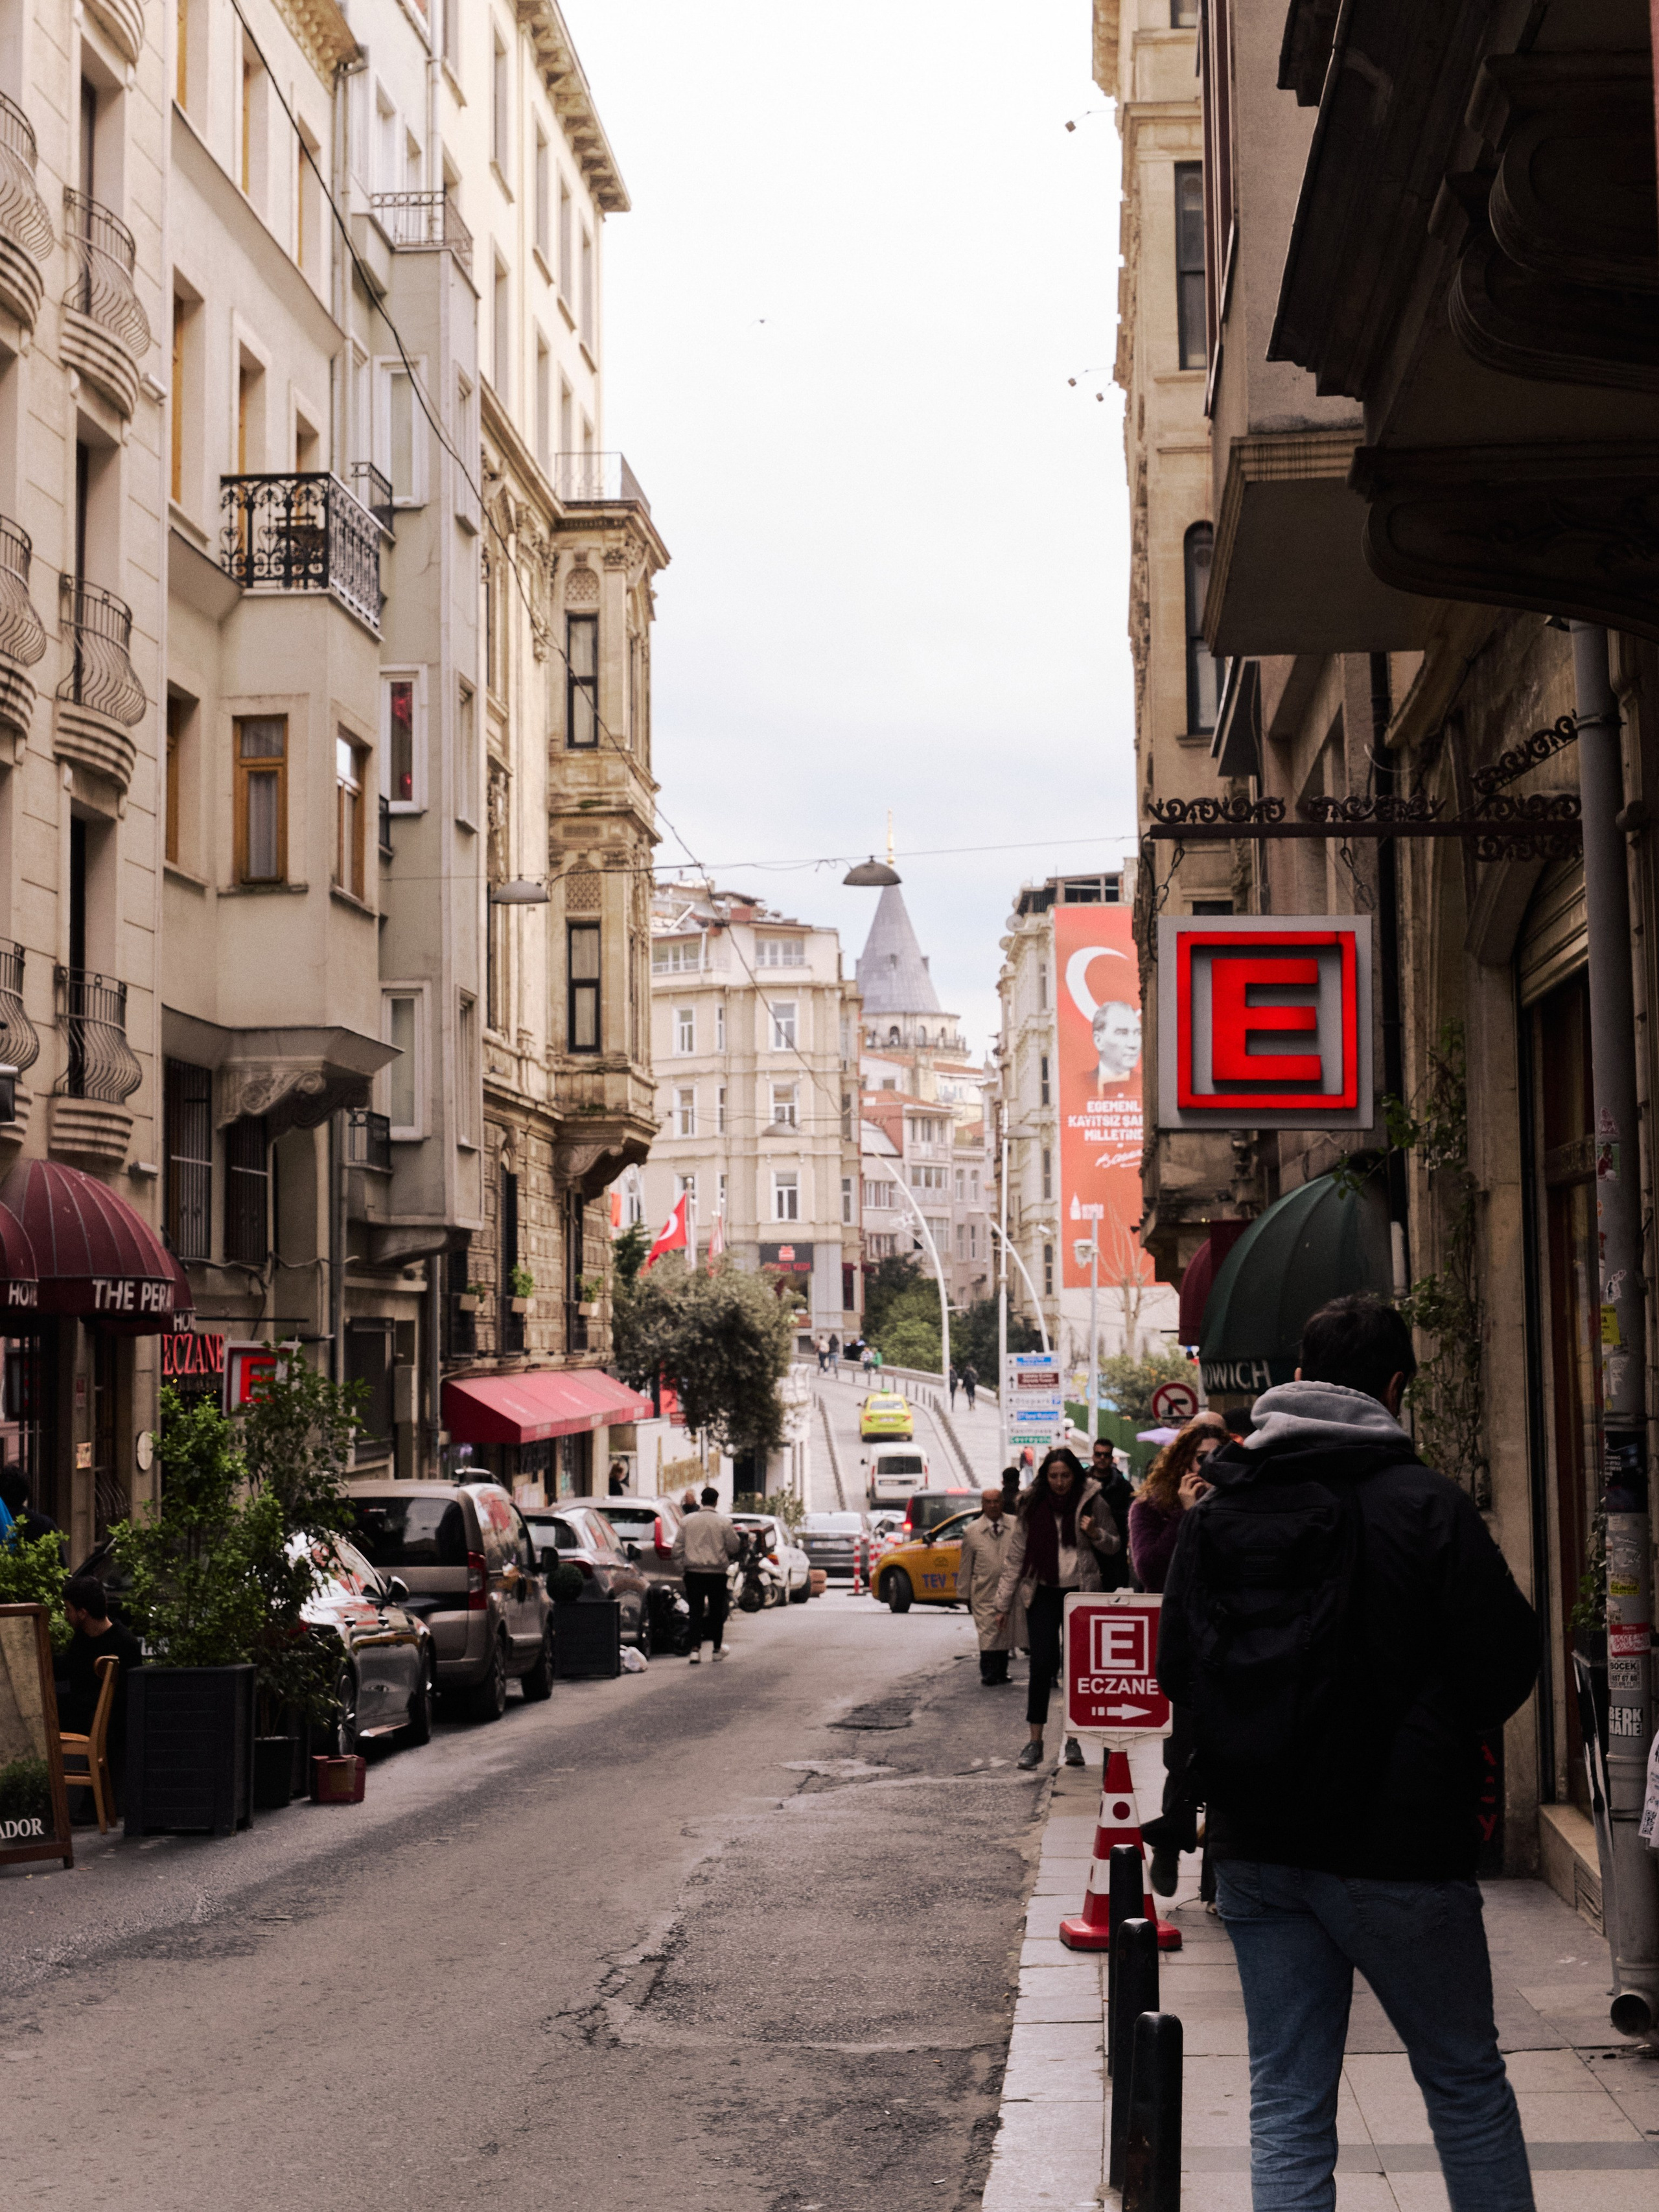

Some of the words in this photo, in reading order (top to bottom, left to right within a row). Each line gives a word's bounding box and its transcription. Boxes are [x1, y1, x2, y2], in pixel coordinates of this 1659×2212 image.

[1212, 959, 1321, 1080] E
[92, 1279, 134, 1310] THE
[163, 1333, 224, 1375] ECZANE
[922, 1572, 947, 1589] TEV
[1101, 1622, 1136, 1668] E
[1077, 1677, 1159, 1695] ECZANE
